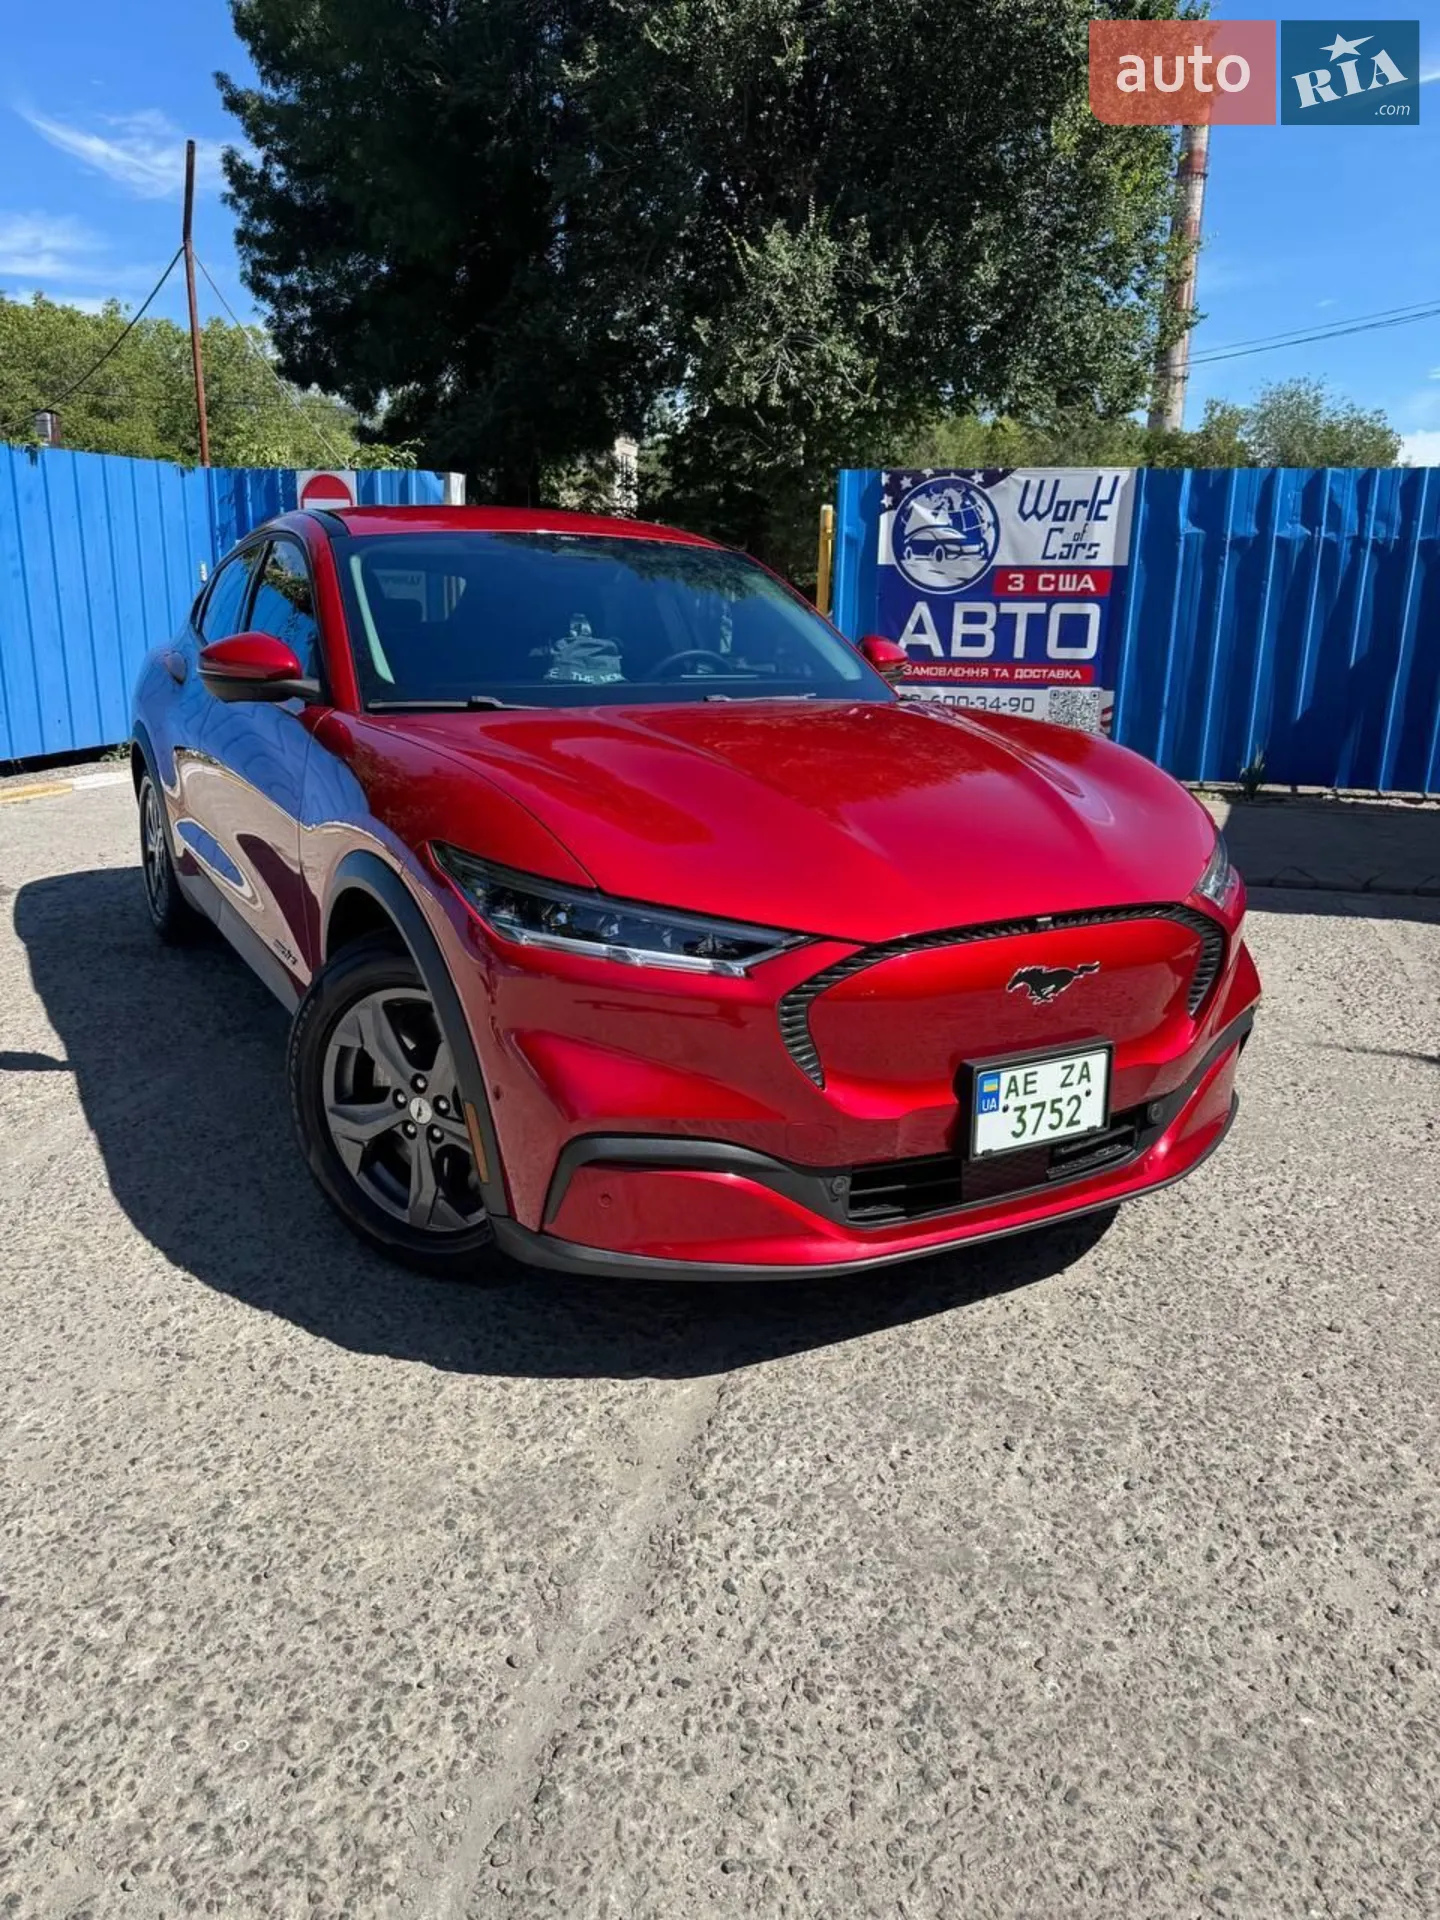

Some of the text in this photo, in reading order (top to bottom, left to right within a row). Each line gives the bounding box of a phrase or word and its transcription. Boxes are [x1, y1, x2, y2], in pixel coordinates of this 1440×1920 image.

[1018, 475, 1119, 522] World
[1041, 527, 1100, 560] Cars
[1073, 523, 1088, 542] of
[1037, 573, 1096, 592] США
[899, 601, 1100, 660] АВТО
[903, 664, 1082, 680] ЗАМОВЛЕННЯ ТА ДОСТАВКА
[1004, 1061, 1091, 1100] AE ZA
[982, 1098, 997, 1112] UA
[1011, 1094, 1082, 1138] 3752
